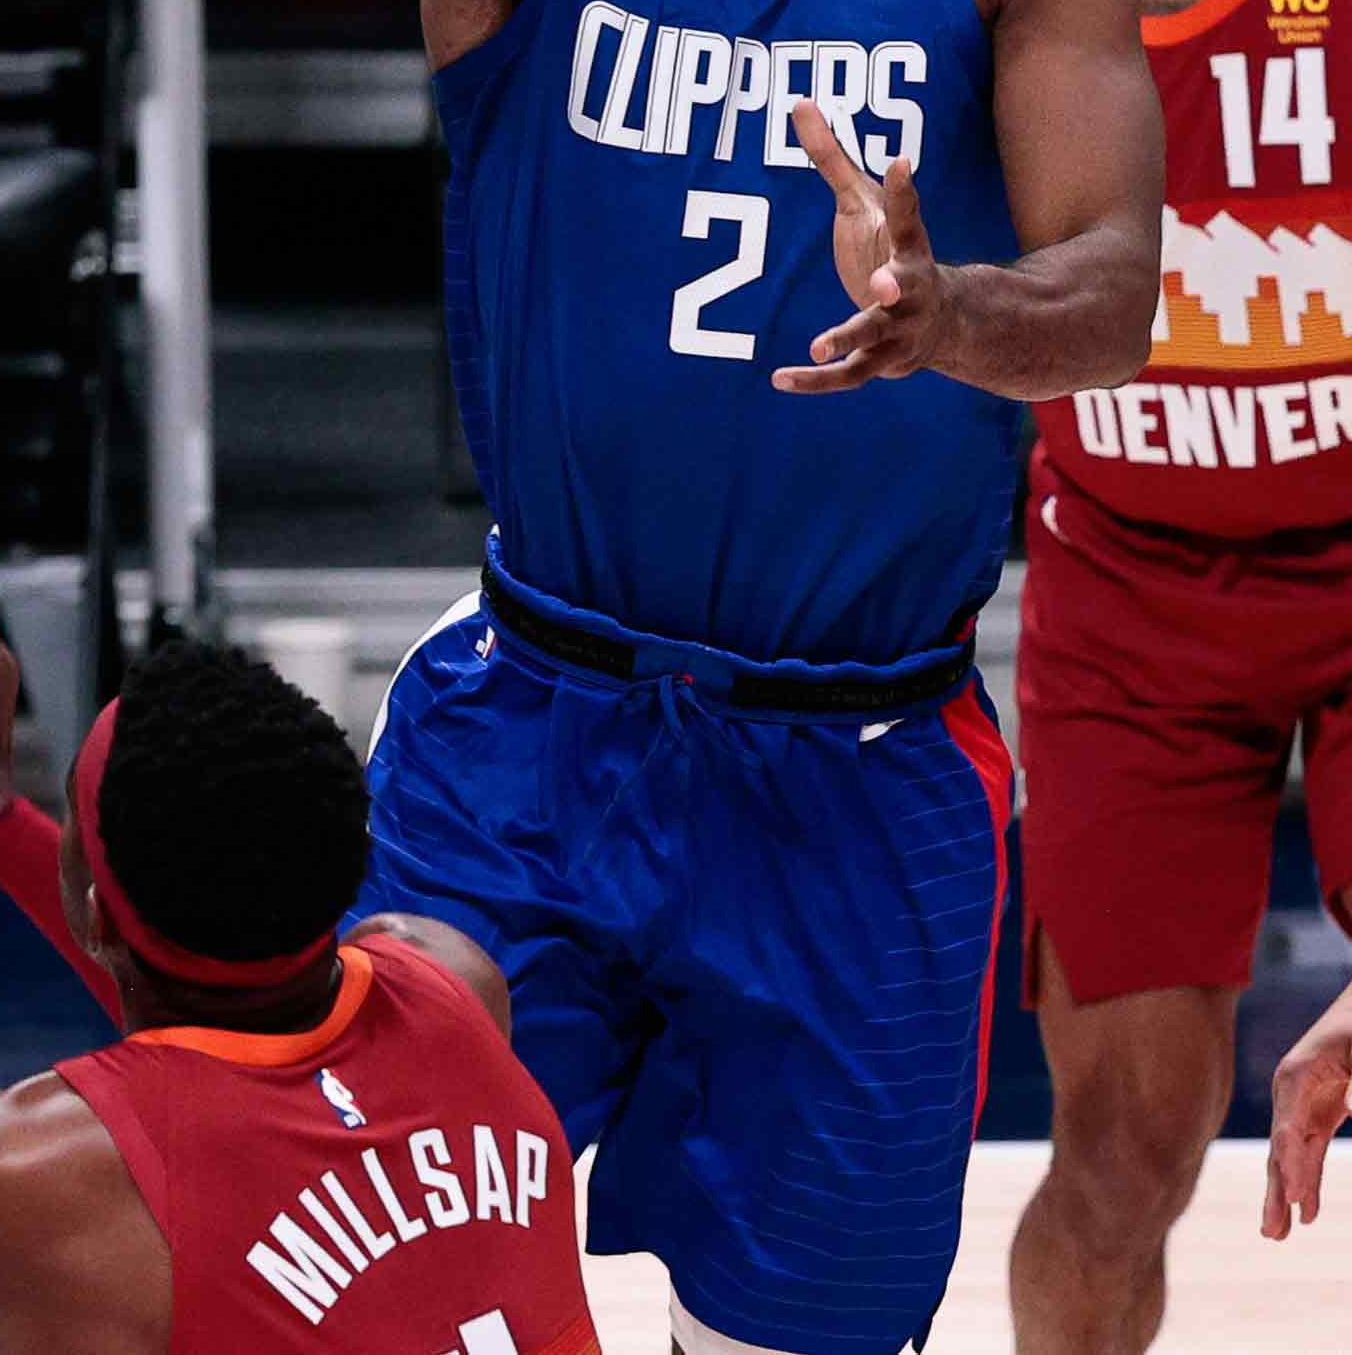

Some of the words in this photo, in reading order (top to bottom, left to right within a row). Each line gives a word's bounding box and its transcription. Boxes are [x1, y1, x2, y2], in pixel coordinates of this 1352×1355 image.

[567, 0, 928, 177] CLIPPERS
[1208, 47, 1337, 189] 14
[668, 190, 771, 362] 2
[245, 1124, 550, 1327] MILLSAP
